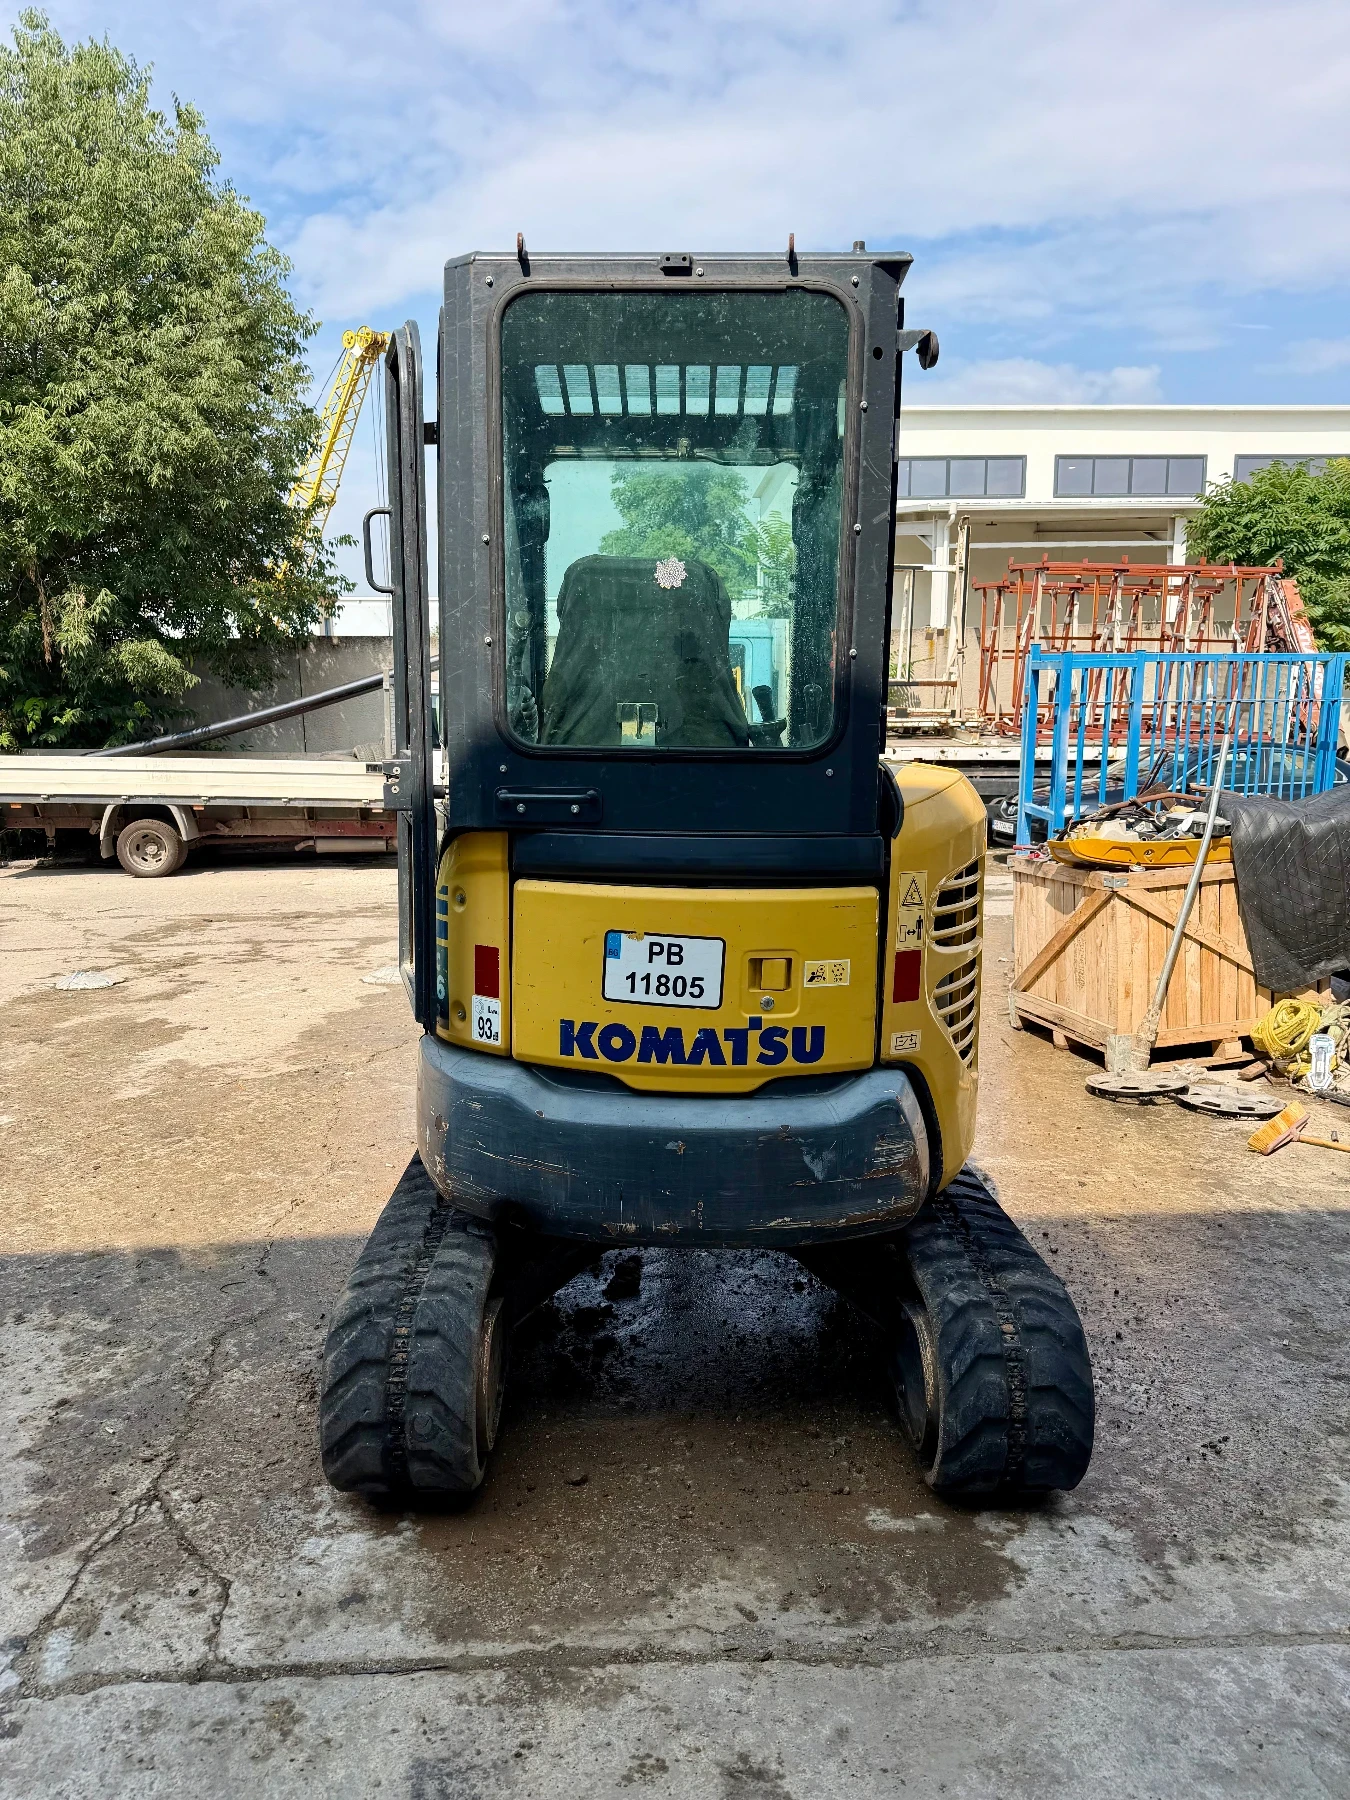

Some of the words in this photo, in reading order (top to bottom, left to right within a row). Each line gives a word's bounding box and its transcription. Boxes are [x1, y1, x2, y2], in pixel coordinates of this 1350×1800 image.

[608, 948, 619, 957] BG
[648, 941, 684, 966] PB
[625, 971, 705, 999] 11805
[477, 1016, 493, 1040] 93
[559, 1016, 826, 1066] KOMATSU
